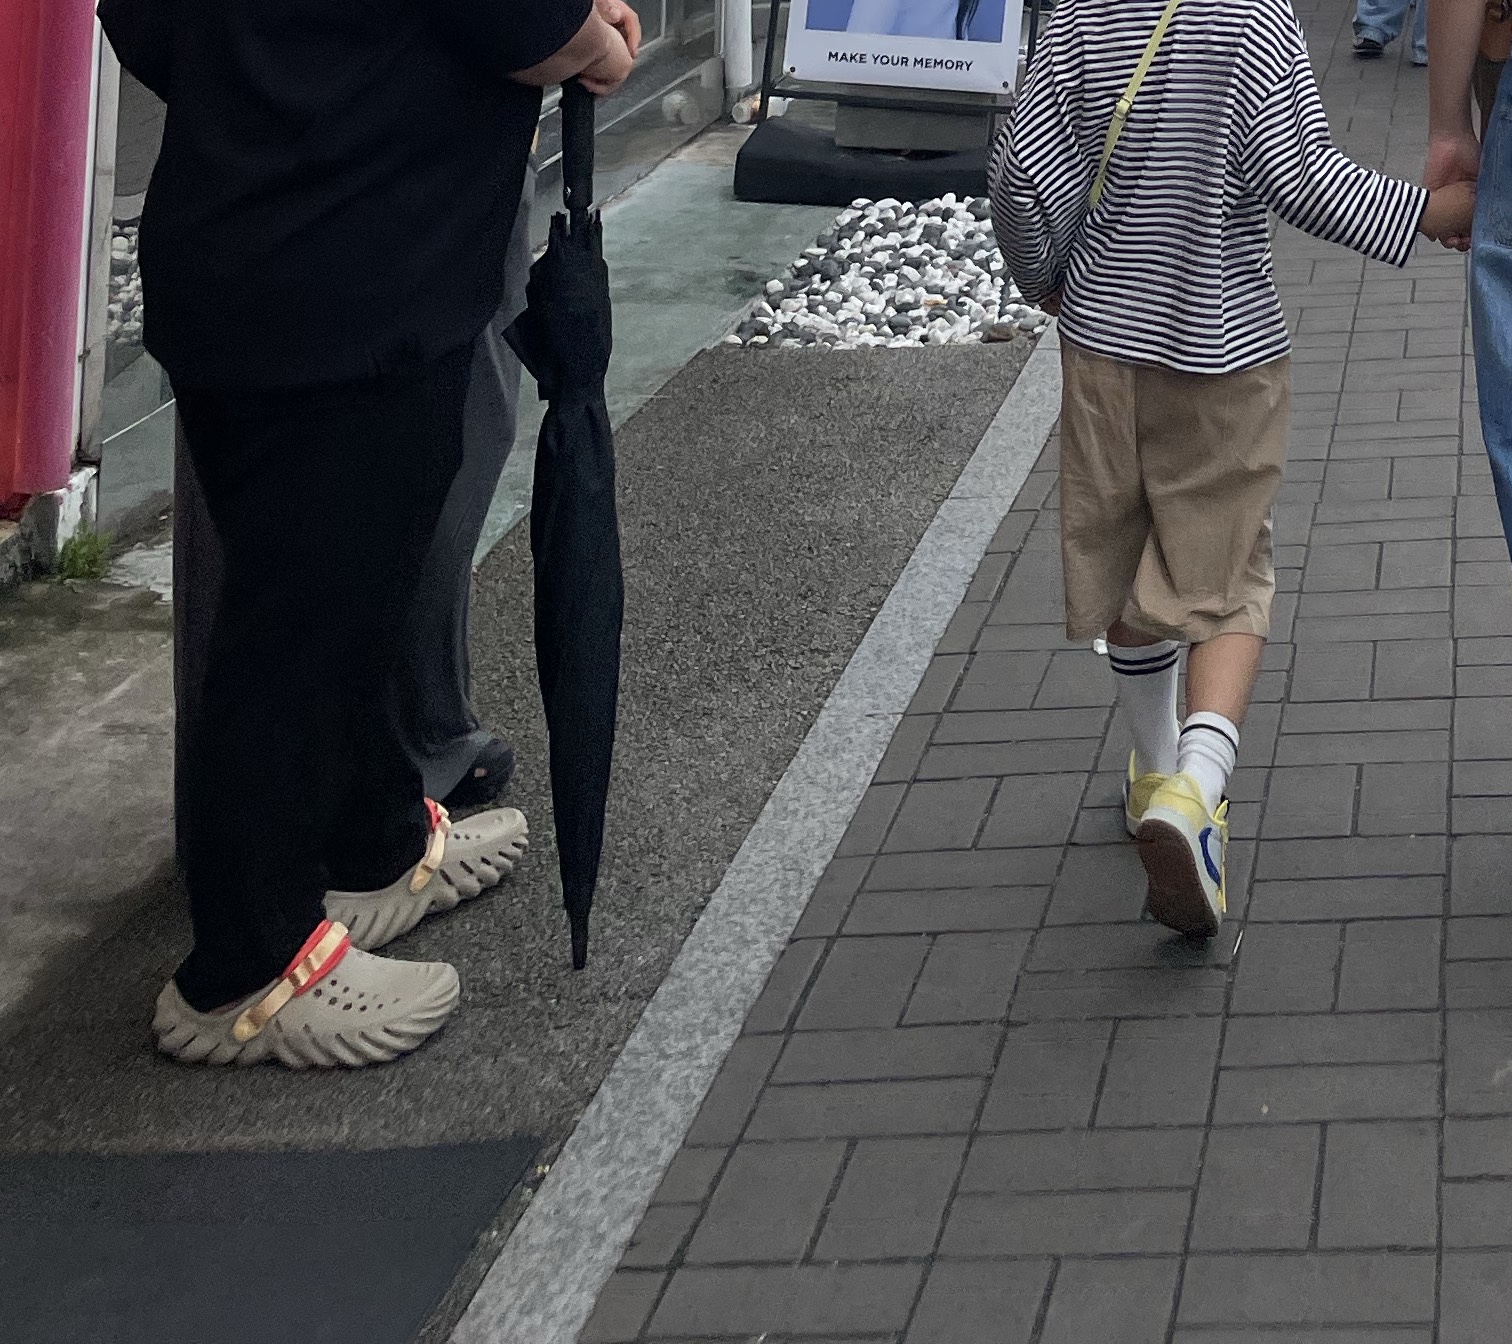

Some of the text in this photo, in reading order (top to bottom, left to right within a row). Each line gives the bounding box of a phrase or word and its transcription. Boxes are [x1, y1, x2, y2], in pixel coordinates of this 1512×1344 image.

[828, 50, 974, 72] MAKE YOUR MEMORY
